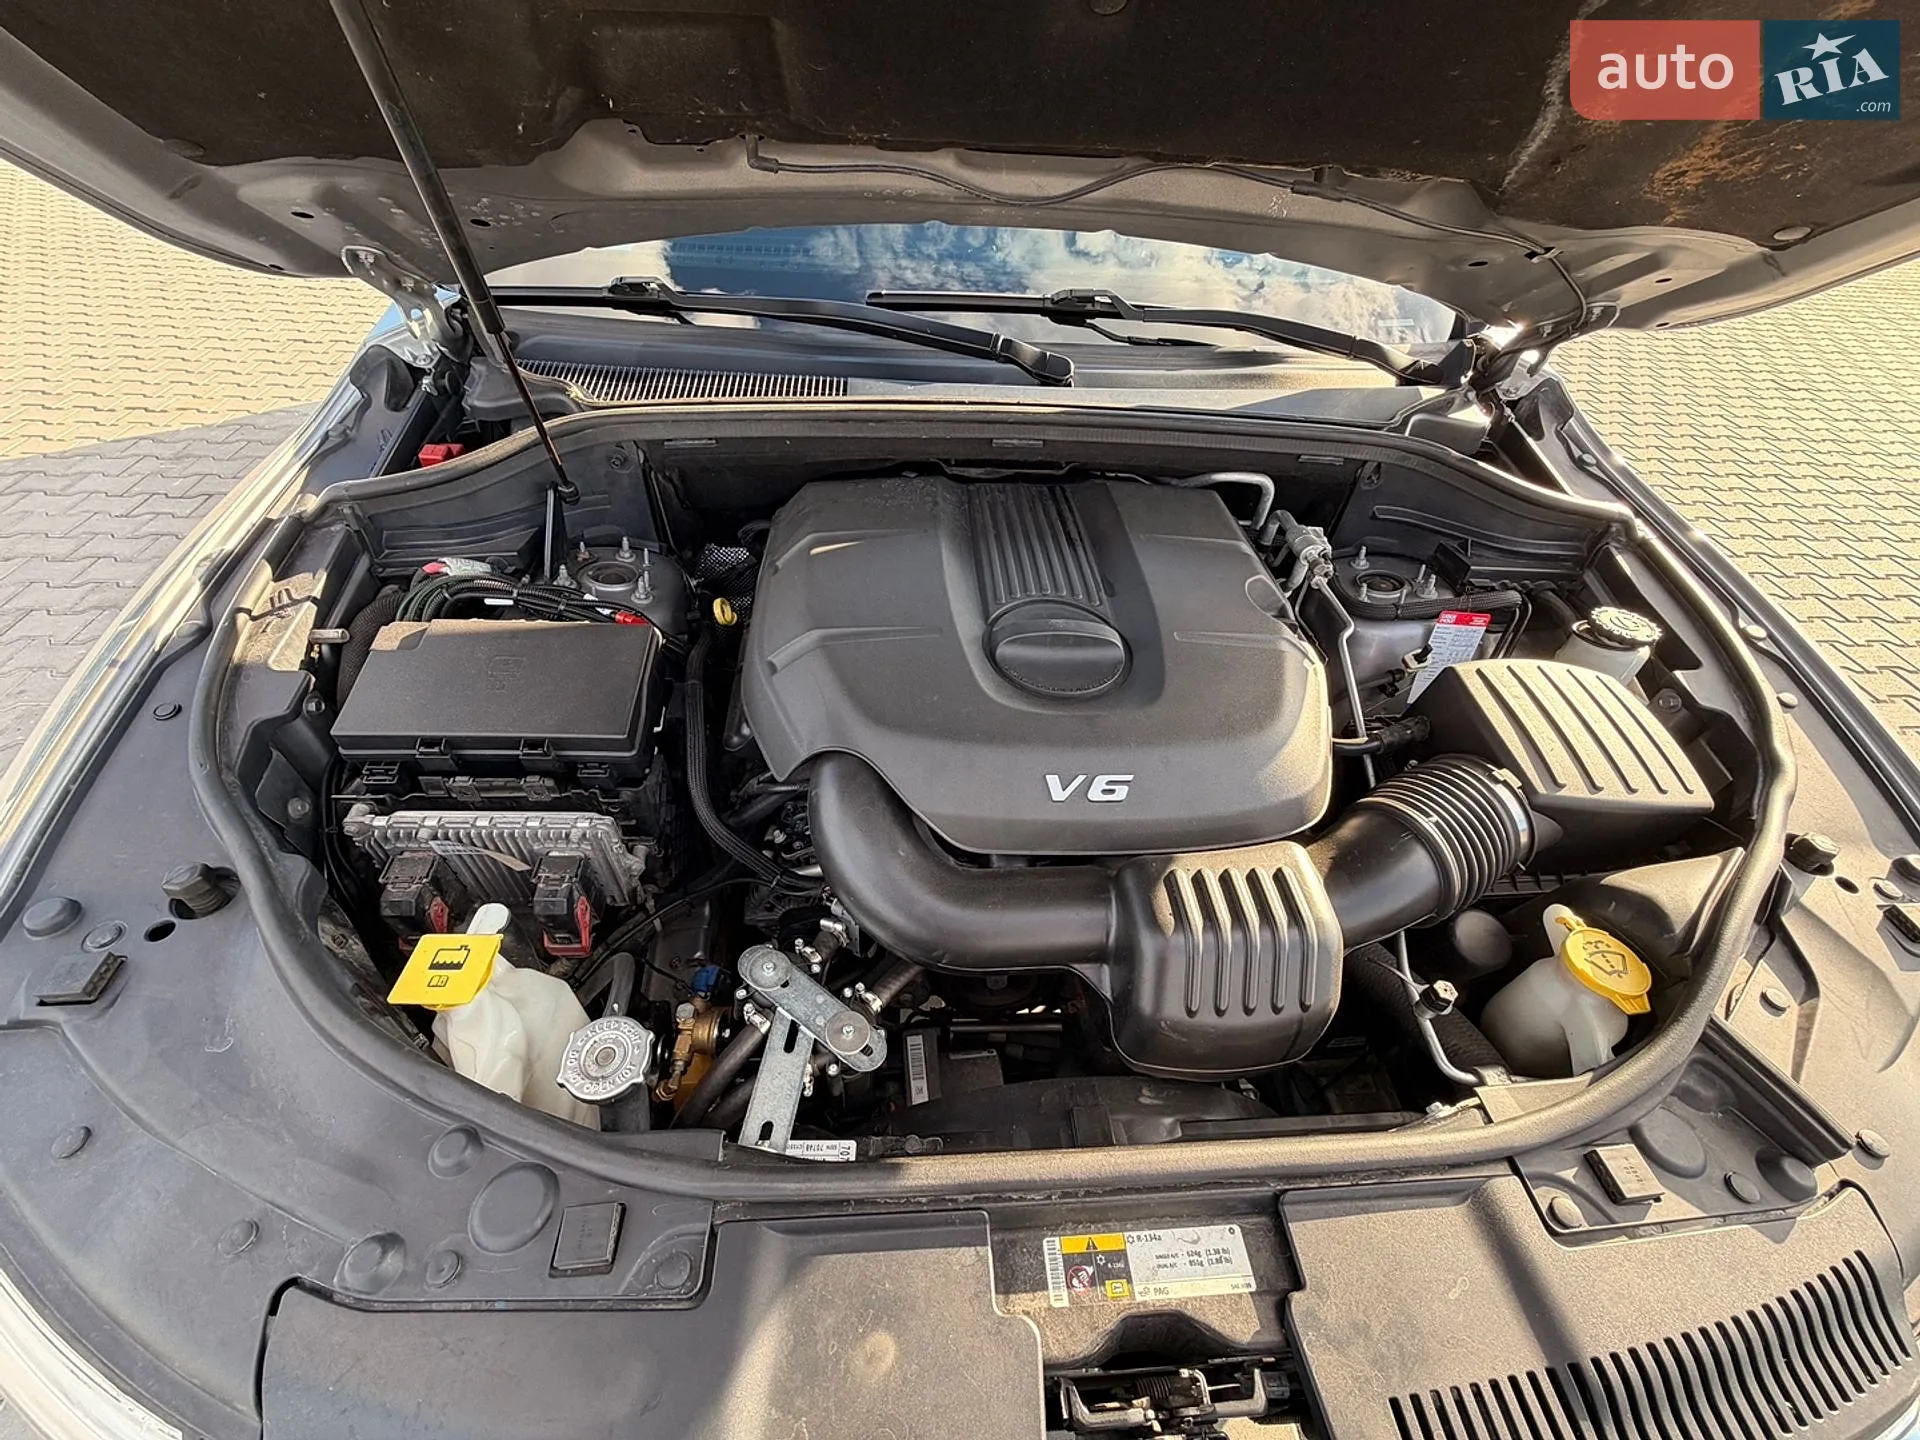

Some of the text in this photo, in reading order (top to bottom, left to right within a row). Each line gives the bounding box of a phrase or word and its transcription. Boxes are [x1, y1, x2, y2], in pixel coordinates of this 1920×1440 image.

[1045, 774, 1135, 803] V6
[567, 1049, 580, 1067] DO
[1136, 1233, 1162, 1243] R-134a
[1153, 1286, 1170, 1296] PAG
